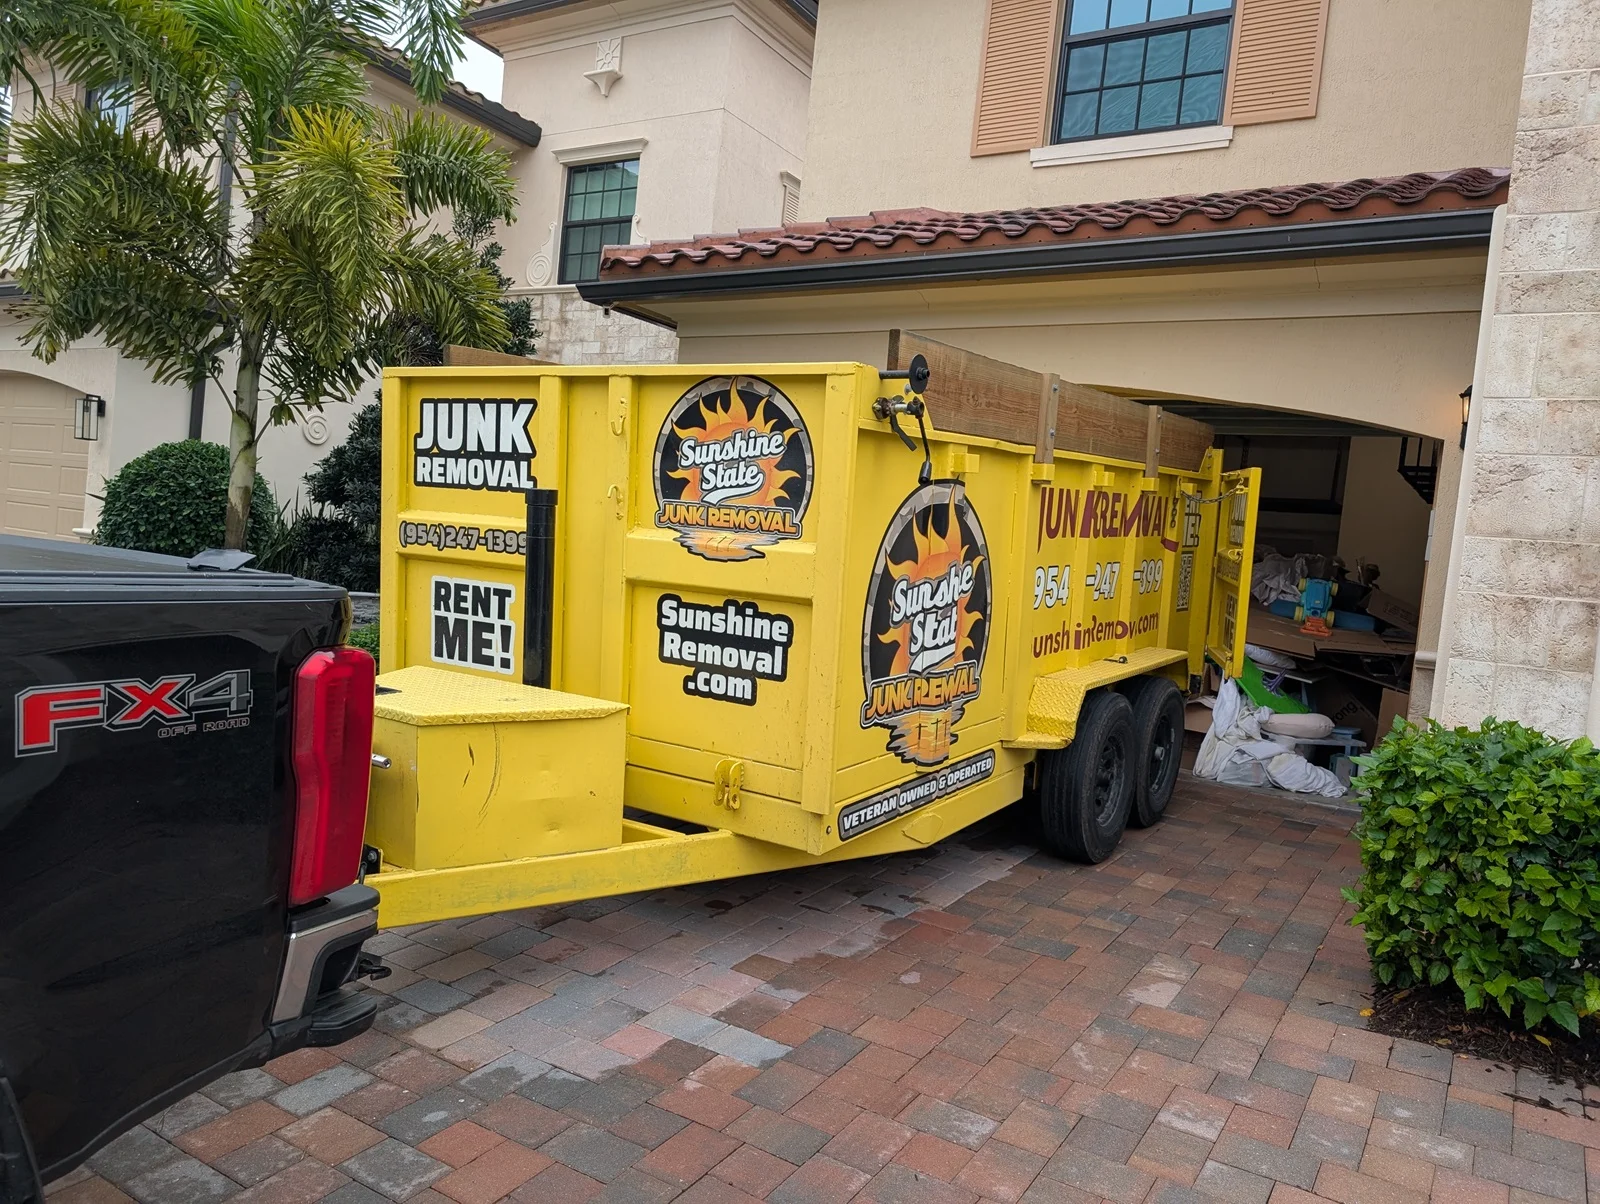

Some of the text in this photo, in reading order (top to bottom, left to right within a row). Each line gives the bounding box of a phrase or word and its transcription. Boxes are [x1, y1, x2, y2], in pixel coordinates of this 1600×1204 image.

[416, 403, 534, 454] JUNK
[680, 430, 785, 467] Sunshine
[416, 456, 534, 489] REMOVAL
[702, 461, 764, 491] State
[400, 521, 526, 554] (954)247-1399
[660, 504, 797, 532] JUNK REMOVAL
[1037, 486, 1101, 554] JUNK
[434, 581, 512, 620] RENT
[893, 564, 974, 623] Sunshe
[661, 599, 789, 642] Sunshine
[909, 605, 958, 654] Stat
[434, 615, 512, 670] ME!
[663, 631, 783, 675] Removal
[687, 671, 752, 700] .com
[866, 679, 913, 718] JUNK
[15, 669, 253, 757] FX4
[158, 717, 250, 738] OFF ROAD
[843, 757, 992, 831] VETERAN OWNED & OPERATED
